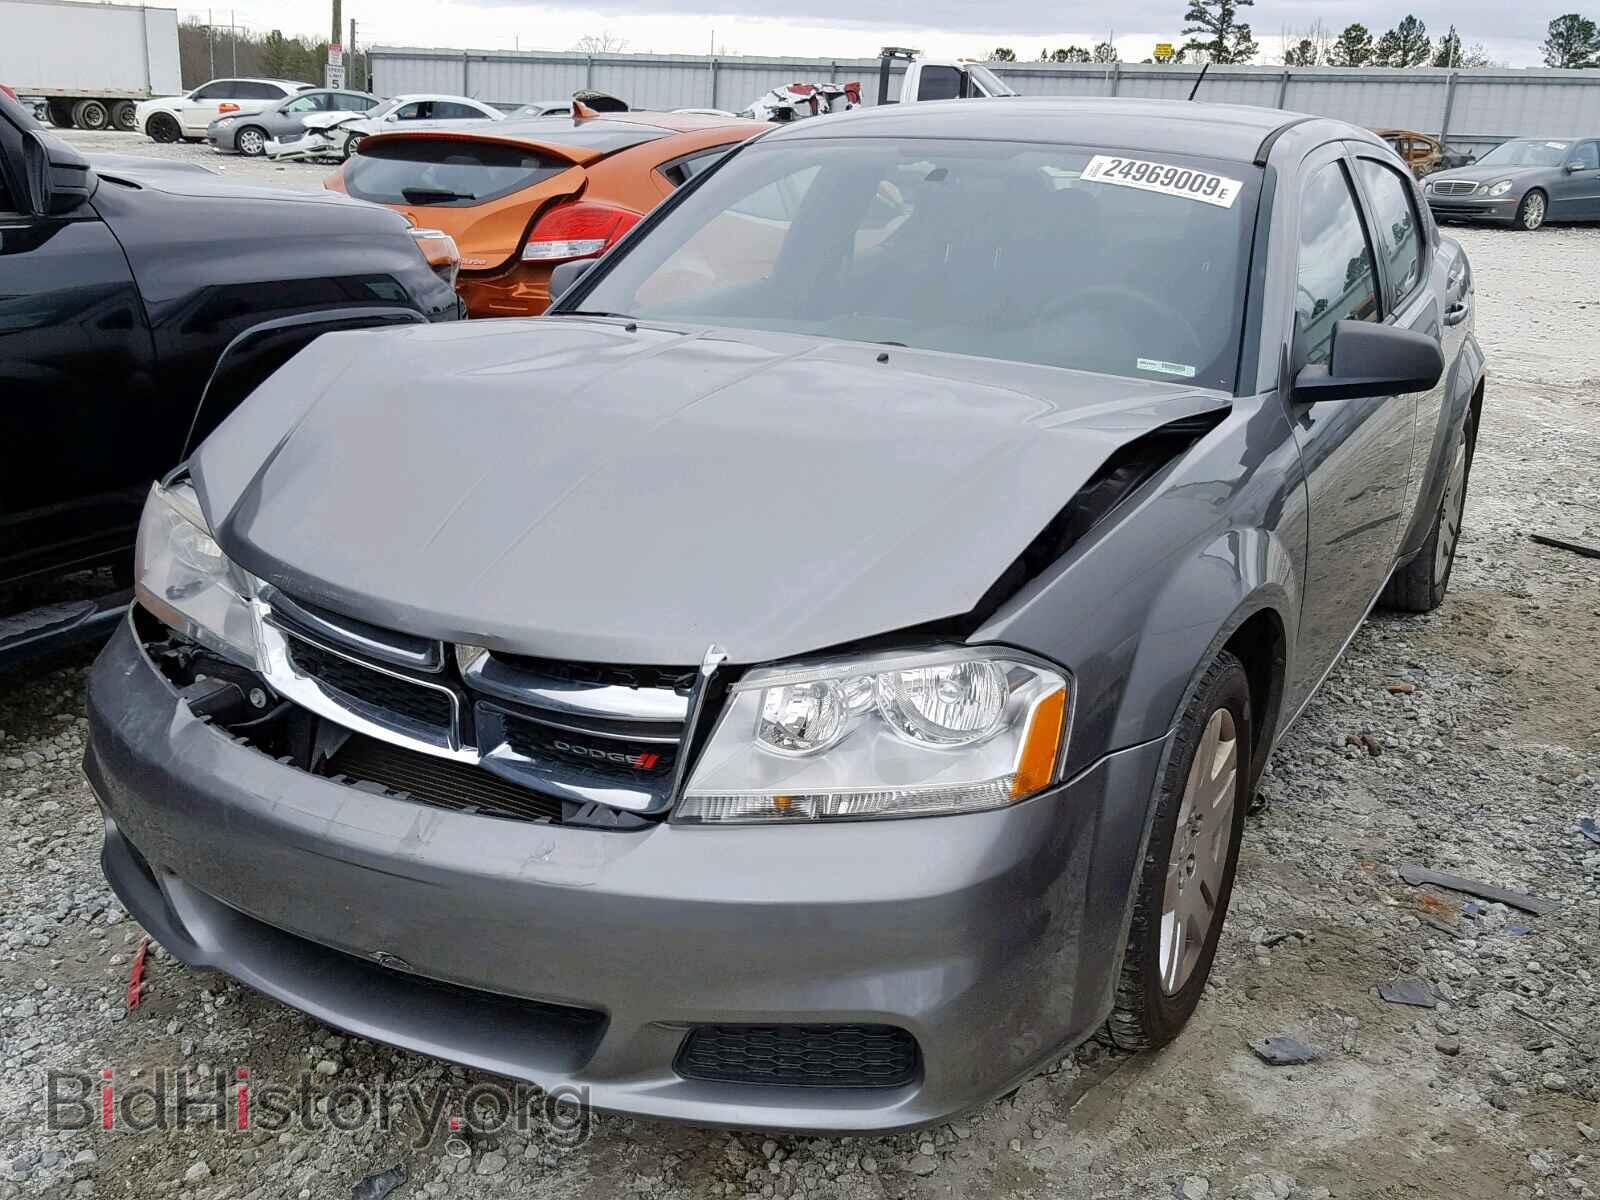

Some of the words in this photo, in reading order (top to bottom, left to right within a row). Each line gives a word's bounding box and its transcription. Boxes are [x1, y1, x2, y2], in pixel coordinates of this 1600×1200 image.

[331, 80, 340, 89] 5
[1103, 159, 1220, 196] 24969009
[553, 740, 644, 766] DODGE
